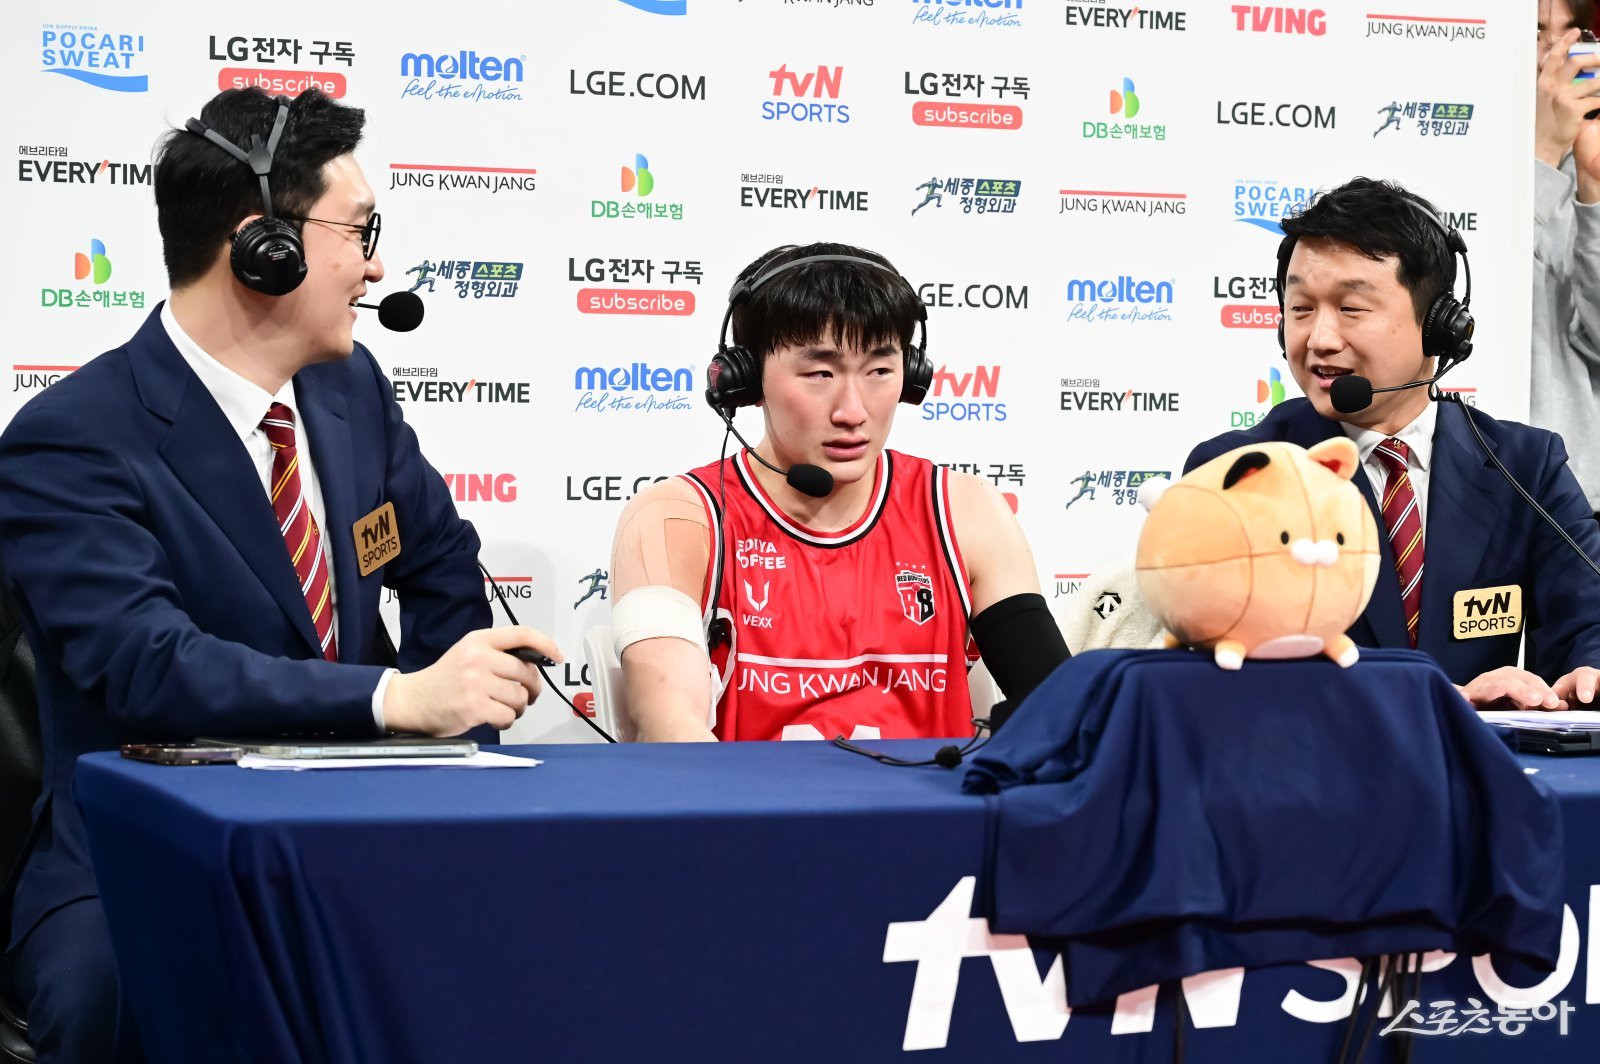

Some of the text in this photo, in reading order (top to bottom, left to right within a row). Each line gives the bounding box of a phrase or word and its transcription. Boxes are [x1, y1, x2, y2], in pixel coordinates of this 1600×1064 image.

[912, 6, 945, 26] feel
[943, 11, 967, 25] the
[1231, 5, 1326, 36] TVING
[42, 31, 144, 51] POCARI
[1366, 21, 1486, 41] JUNG KWAN JANG
[42, 49, 135, 69] SWEAT
[209, 35, 356, 67] LG전자 구독
[401, 50, 524, 82] molten
[232, 72, 336, 93] subscribe
[401, 78, 437, 100] feel
[435, 83, 462, 99] the
[571, 69, 706, 100] LGE.COM
[769, 63, 844, 99] tvN
[904, 71, 1031, 100] LG전자 구독
[761, 101, 850, 124] SPORTS
[924, 106, 1013, 125] subscribe
[1217, 101, 1336, 129] LGE.COM
[1082, 122, 1166, 141] DB손해보험
[1416, 119, 1470, 137] 정형외과
[19, 145, 68, 157] 에브리타임
[390, 172, 536, 194] JUNG KWAN JANG
[741, 173, 783, 184] 에브리타임
[592, 200, 683, 220] DB손해보험
[959, 196, 1017, 215] 정형외과
[1060, 197, 1186, 217] JUNG KWAN JANG
[568, 258, 704, 285] LG전자 구독
[41, 288, 145, 309] DB손해보험
[454, 281, 519, 299] 정형외과
[918, 283, 1028, 309] GE.COM
[1068, 276, 1173, 303] molten
[590, 293, 686, 311] subscribe
[1067, 303, 1096, 321] feel
[1098, 304, 1120, 319] the
[392, 367, 438, 377] 에브리타임
[575, 363, 693, 392] molten
[932, 364, 1001, 398] tvN
[1060, 378, 1100, 388] 에브리타임
[575, 391, 606, 413] feel
[608, 395, 632, 410] the
[922, 402, 1007, 422] SPORTS
[987, 464, 1026, 486] 구독
[361, 510, 391, 549] tvN
[362, 536, 398, 568] SPORTS
[738, 538, 778, 553] EDIYA
[736, 549, 787, 570] COFFEE
[489, 585, 532, 603] JANG
[1055, 581, 1082, 598] JUN
[1463, 591, 1511, 617] tvN
[742, 613, 773, 629] VEXX
[1459, 615, 1516, 633] SPORTS
[798, 666, 879, 699] KWAN
[882, 668, 946, 694] JANG
